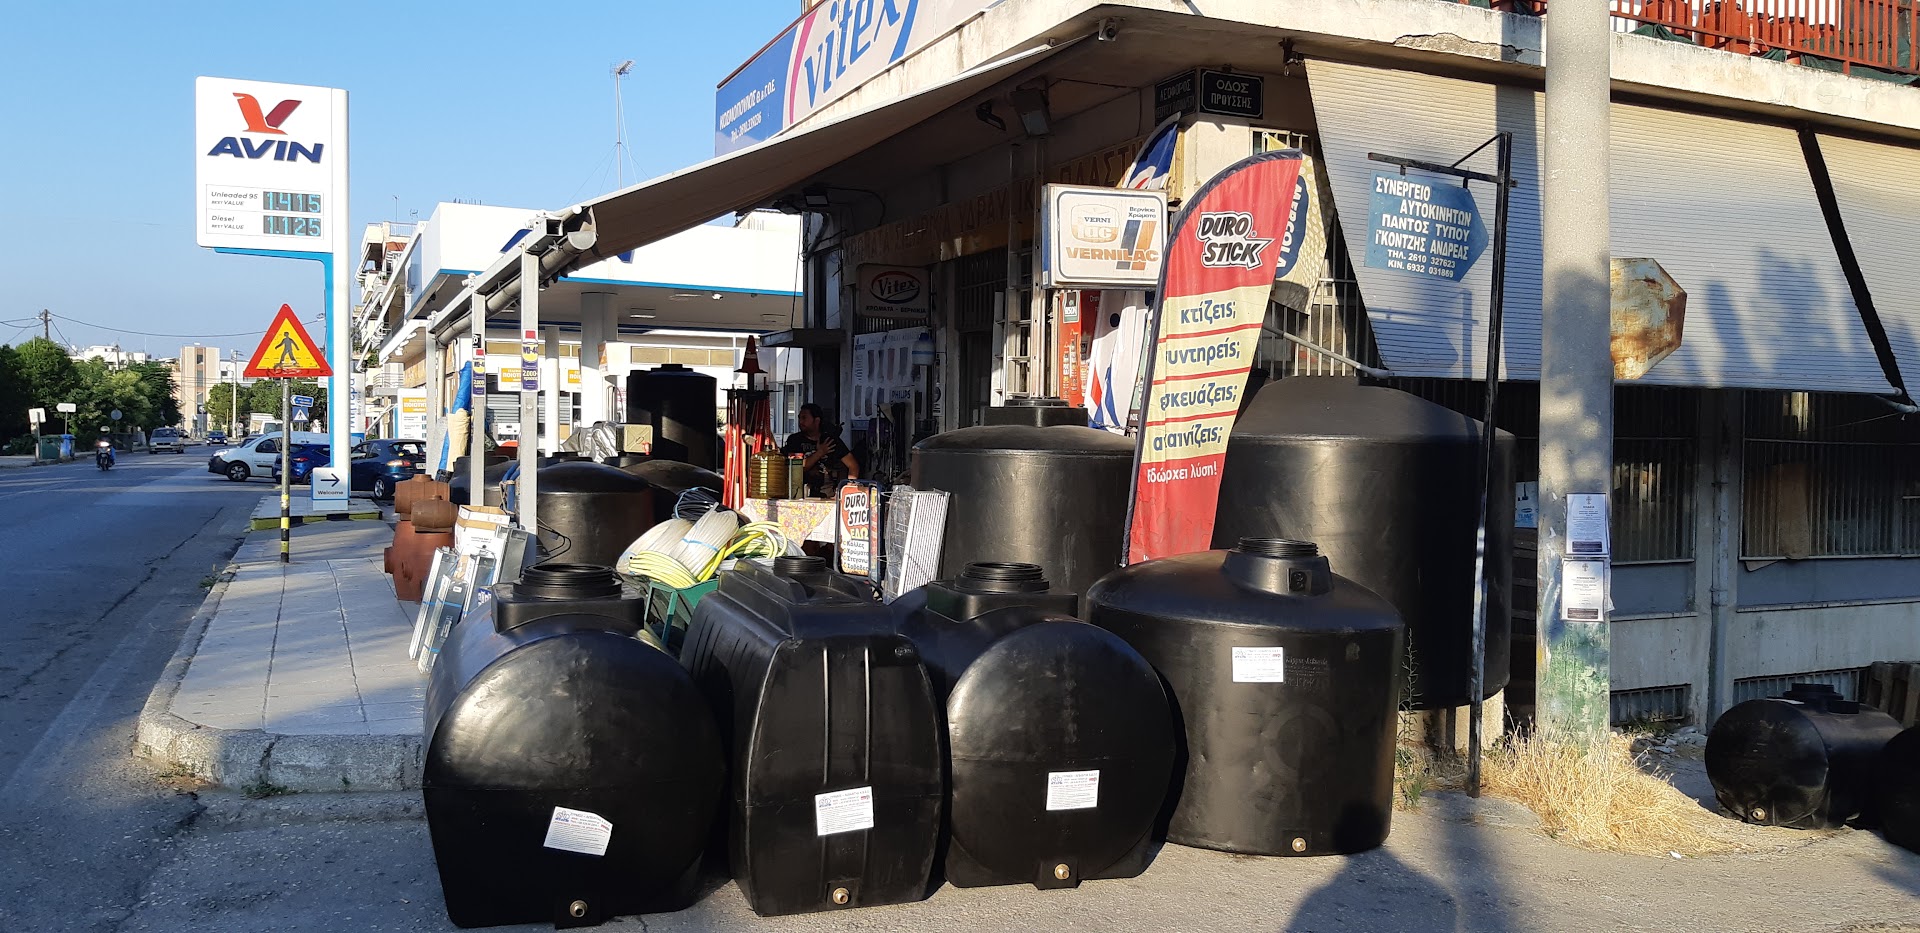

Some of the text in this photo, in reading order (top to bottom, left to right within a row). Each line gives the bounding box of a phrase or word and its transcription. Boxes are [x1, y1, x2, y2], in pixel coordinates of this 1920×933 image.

[1216, 80, 1249, 93] ΟΔΟΣ
[1211, 93, 1252, 108] ΠΡΟΥΣΣΗΣ
[207, 136, 324, 164] AVIN
[1376, 176, 1431, 201] ΣΥΝΕΡΓΕΙΟ
[211, 191, 248, 200] Unleaded
[266, 192, 321, 213] 1.415
[1400, 199, 1472, 227] ΑΥΤΟΚΙΝΗΤΩΝ
[266, 216, 321, 236] 1.125
[1201, 216, 1249, 236] DURO
[1382, 214, 1470, 242] ΠΑΝΤΟΣ ΤΥΠΟΥ
[1066, 246, 1159, 262] VERNILAC
[1205, 242, 1261, 264] STICK
[1387, 249, 1456, 269] ΤΗΛ. 2610 327623
[1430, 240, 1469, 260] ΑΝΔΡΕΑΣ
[1388, 260, 1405, 270] ΚΙΝ.
[1406, 263, 1425, 273] 6932
[879, 277, 916, 296] Vitex
[1181, 299, 1236, 324] κτίζεις;
[1191, 461, 1217, 478] λύση!
[845, 495, 866, 509] DURO
[851, 527, 869, 539] ΕΔΩ
